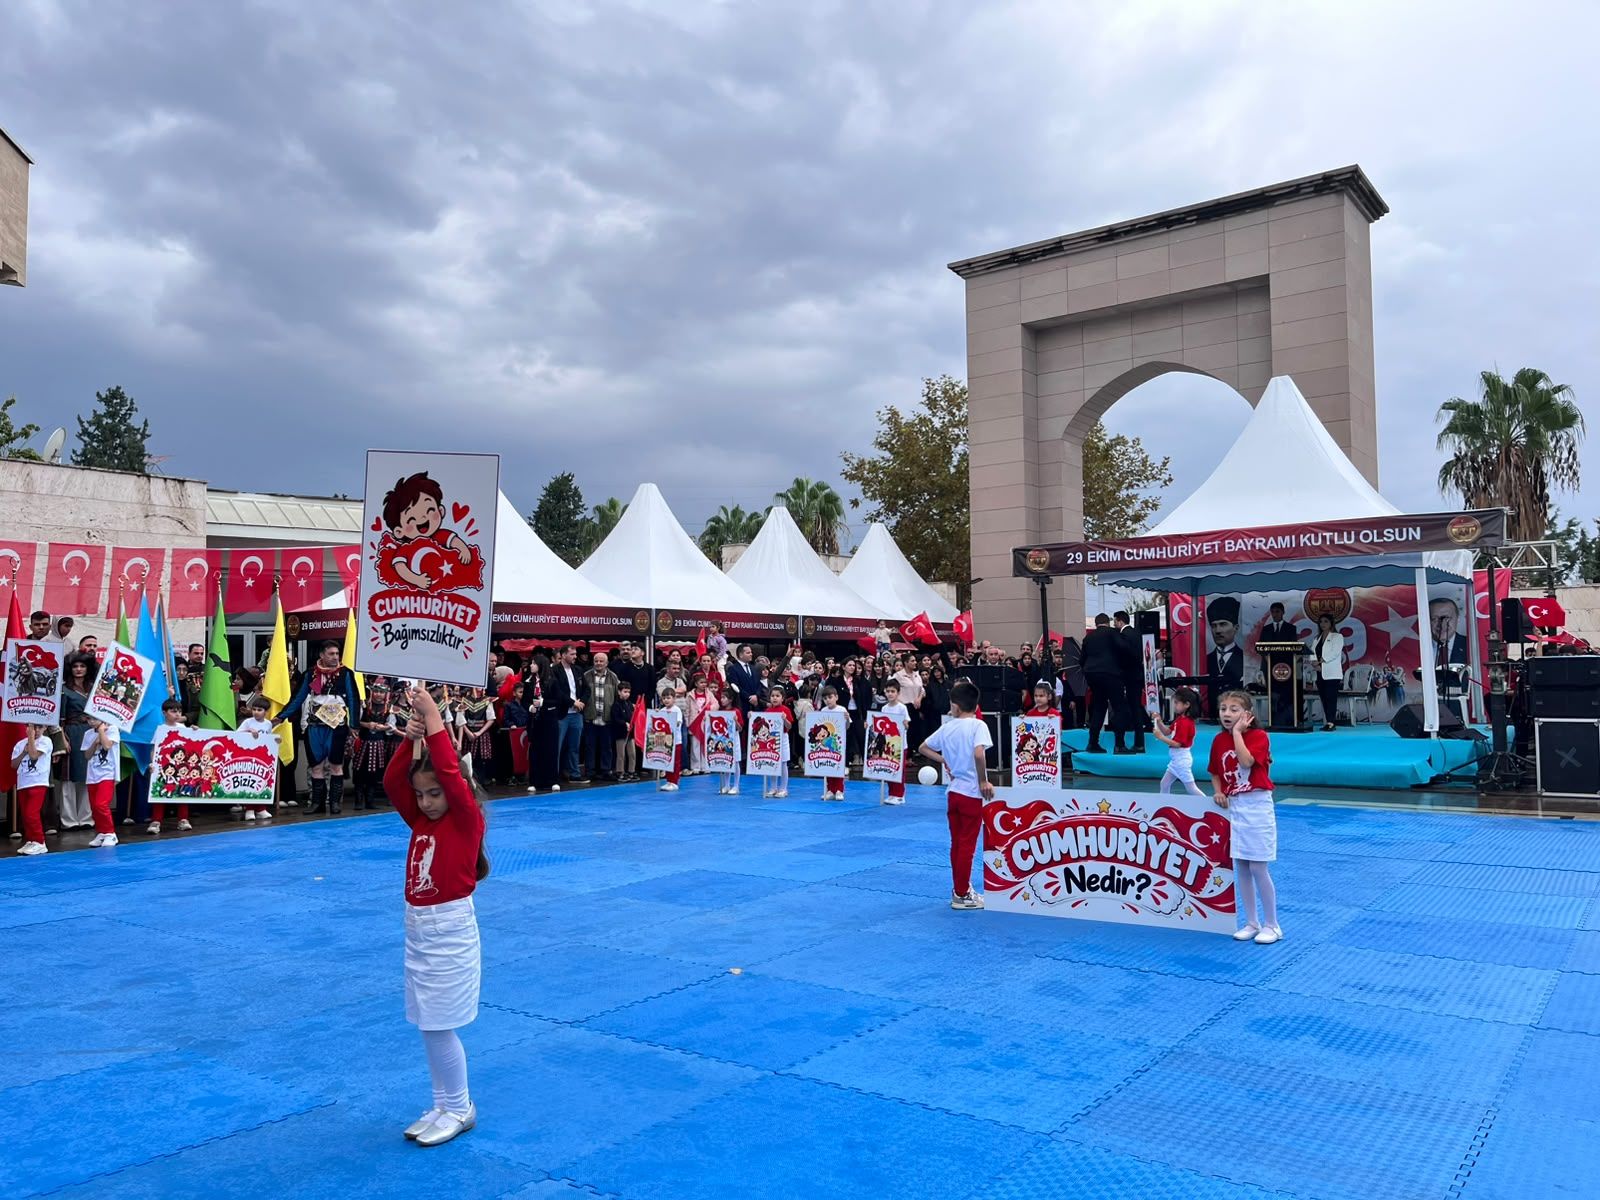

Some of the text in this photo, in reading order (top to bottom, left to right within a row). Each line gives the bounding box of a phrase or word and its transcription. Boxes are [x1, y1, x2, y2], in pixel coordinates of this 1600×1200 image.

[1066, 527, 1421, 565] 29 EKİM CUMHURİYET BAYRAMI KUTLU OLSUN
[375, 596, 477, 625] CUMHURİYET
[492, 612, 633, 626] EKİM CUMHURİYET BAYRAMI KUTLU OLSUN
[301, 622, 308, 631] 29
[381, 623, 464, 650] Bağımsızlıktır
[9, 697, 55, 711] CUMHURİYET
[222, 759, 269, 778] CUMHURİYET
[1018, 762, 1057, 774] CUMHURİYET
[232, 775, 256, 789] Biziz
[1012, 821, 1206, 886] CUMHURİYET
[1063, 864, 1152, 900] Nedir?
